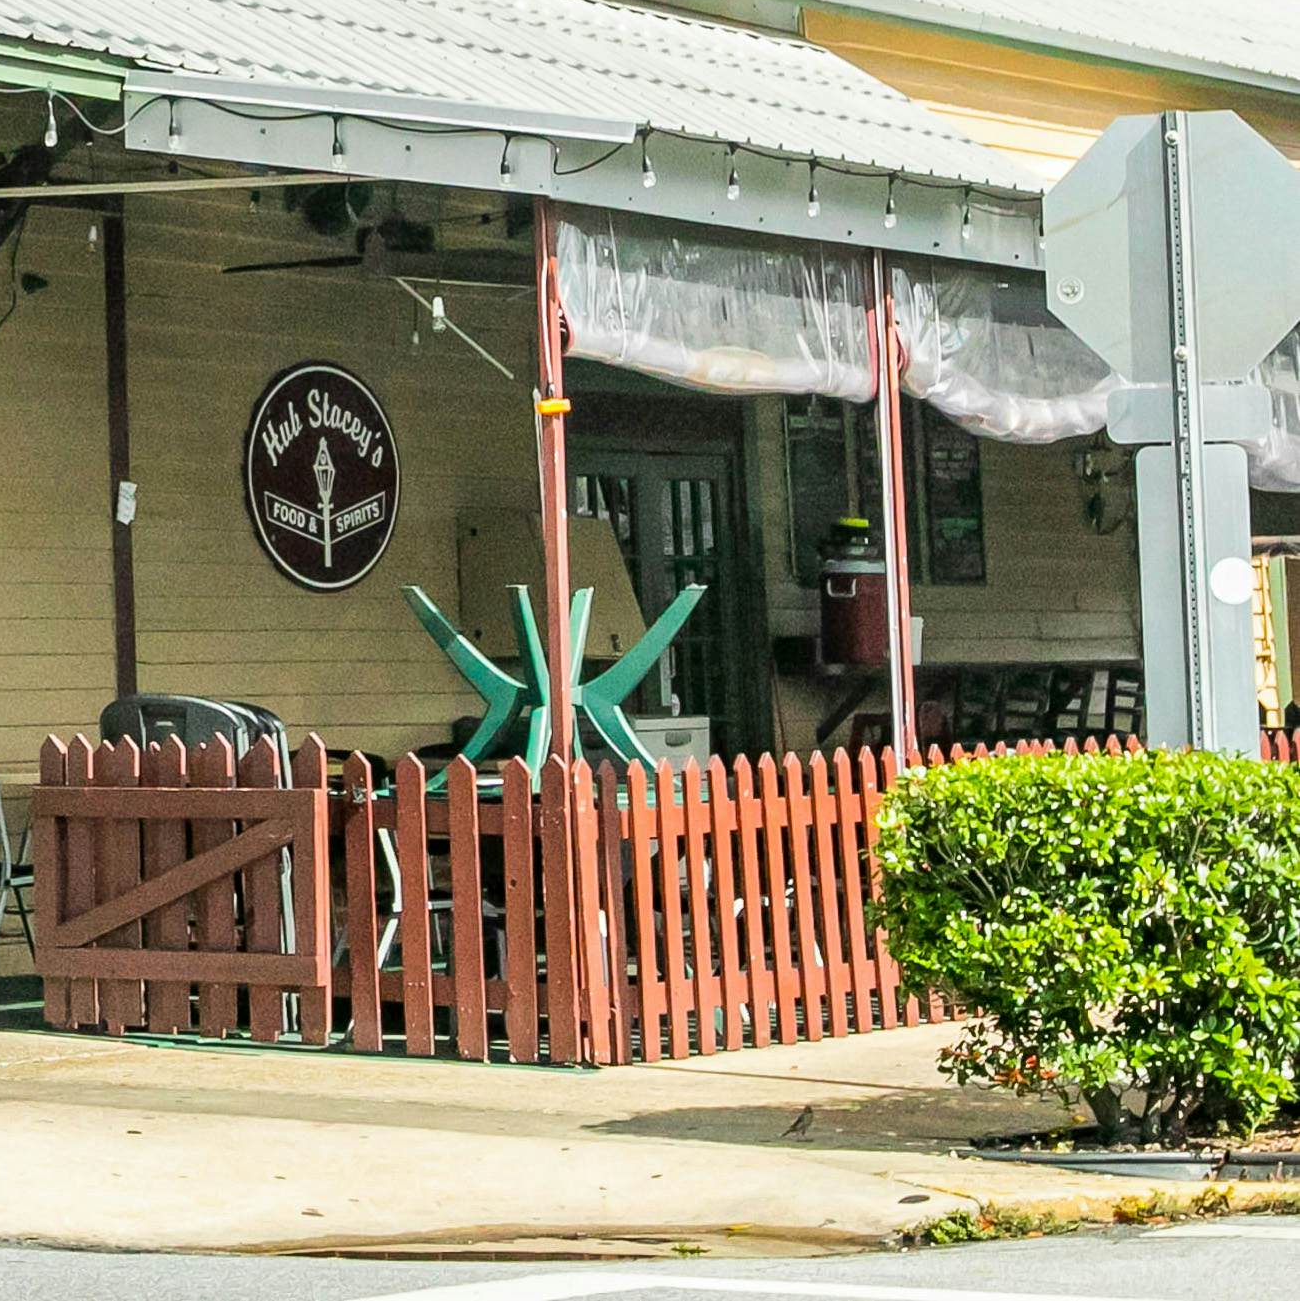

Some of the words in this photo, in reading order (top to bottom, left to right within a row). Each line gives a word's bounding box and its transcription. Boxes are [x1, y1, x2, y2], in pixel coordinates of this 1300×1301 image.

[262, 401, 303, 467] Hub
[307, 388, 383, 468] Stacey's
[273, 502, 306, 528] FOOD
[309, 516, 318, 534] &
[336, 501, 381, 533] SPIRITS
